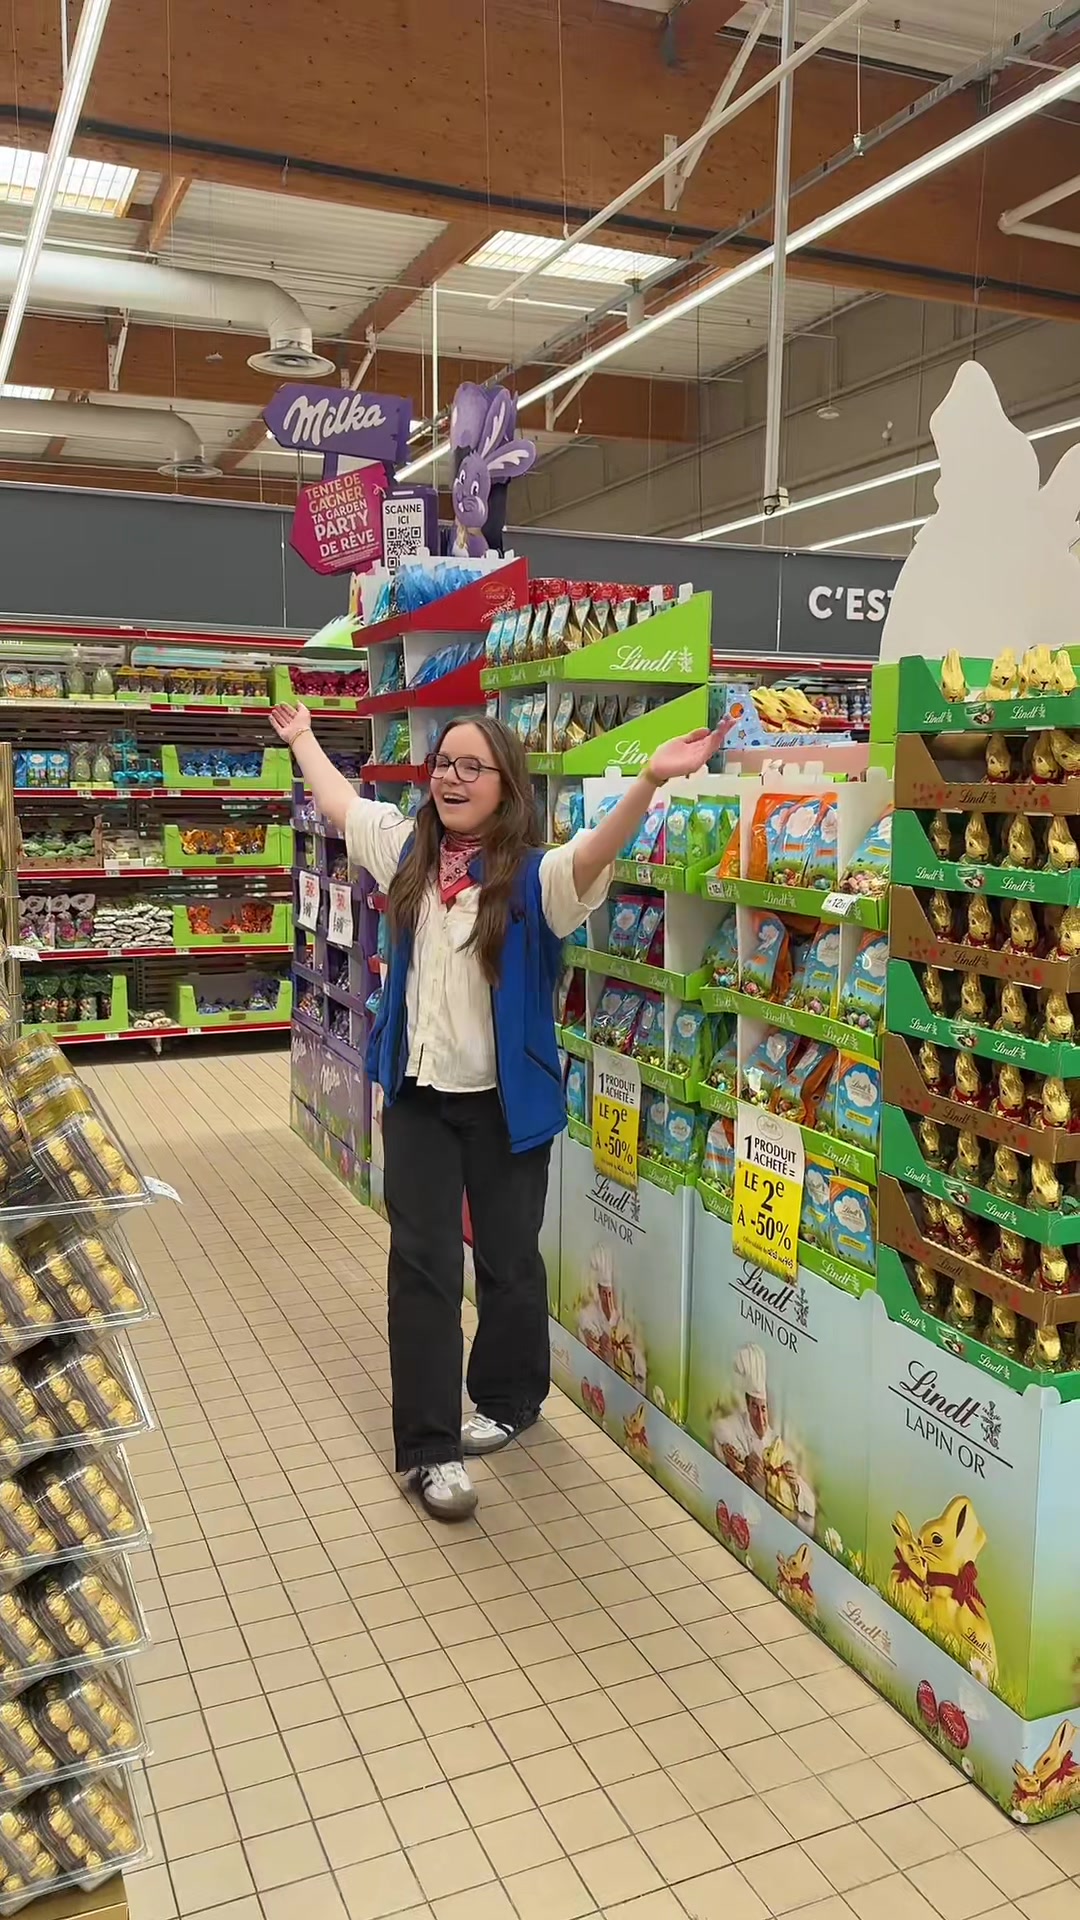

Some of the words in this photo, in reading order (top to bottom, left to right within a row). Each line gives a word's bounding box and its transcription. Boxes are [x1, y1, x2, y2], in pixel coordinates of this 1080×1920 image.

[283, 393, 386, 446] Milka
[305, 479, 343, 500] TENTE
[344, 473, 361, 488] DE
[309, 486, 364, 514] GAGNER
[312, 513, 325, 525] TA
[326, 498, 368, 520] GARDEN
[385, 503, 422, 514] SCANNE
[314, 509, 369, 541] PARTY
[398, 515, 410, 525] ICI
[320, 541, 339, 557] DE
[340, 529, 375, 551] RÊVE
[609, 645, 679, 673] Lindt
[923, 711, 947, 724] Lindt
[1010, 705, 1039, 719] Lindt
[607, 740, 649, 765] Lin
[771, 736, 798, 748] Lindt
[959, 789, 989, 804] Lindt
[916, 867, 939, 880] Lindt
[1002, 877, 1030, 892] Lindt
[952, 951, 982, 967] Lindt
[909, 1018, 931, 1035] Lindt
[992, 1039, 1021, 1057] Lindt
[598, 1072, 605, 1094] 1
[605, 1073, 636, 1094] PRODUIT
[599, 1102, 610, 1119] LE
[611, 1108, 628, 1135] 2e
[942, 1107, 972, 1125] Lindt
[604, 1135, 633, 1164] -50%
[744, 1134, 752, 1160] 1
[754, 1137, 797, 1164] PRODUIT
[753, 1151, 788, 1175] ACHETÉ
[904, 1165, 926, 1184] Lindt
[591, 1173, 632, 1213] Lindt
[744, 1170, 758, 1192] LE
[761, 1180, 785, 1213] 2e
[984, 1201, 1012, 1220] Lindt
[593, 1207, 619, 1237] LAPIN
[619, 1226, 634, 1245] OR
[737, 1204, 746, 1227] À
[751, 1211, 792, 1251] -50%
[822, 1260, 853, 1286] Lindt
[736, 1260, 796, 1313] Lindt
[740, 1299, 774, 1337] LAPIN
[777, 1326, 798, 1354] OR
[900, 1310, 922, 1330] Lindt
[978, 1353, 1005, 1374] Lindt
[898, 1360, 980, 1428] Lindt
[906, 1407, 953, 1456] LAPIN
[958, 1445, 986, 1479] OR
[842, 1600, 882, 1641] Lindt
[964, 1627, 987, 1652] Lindt
